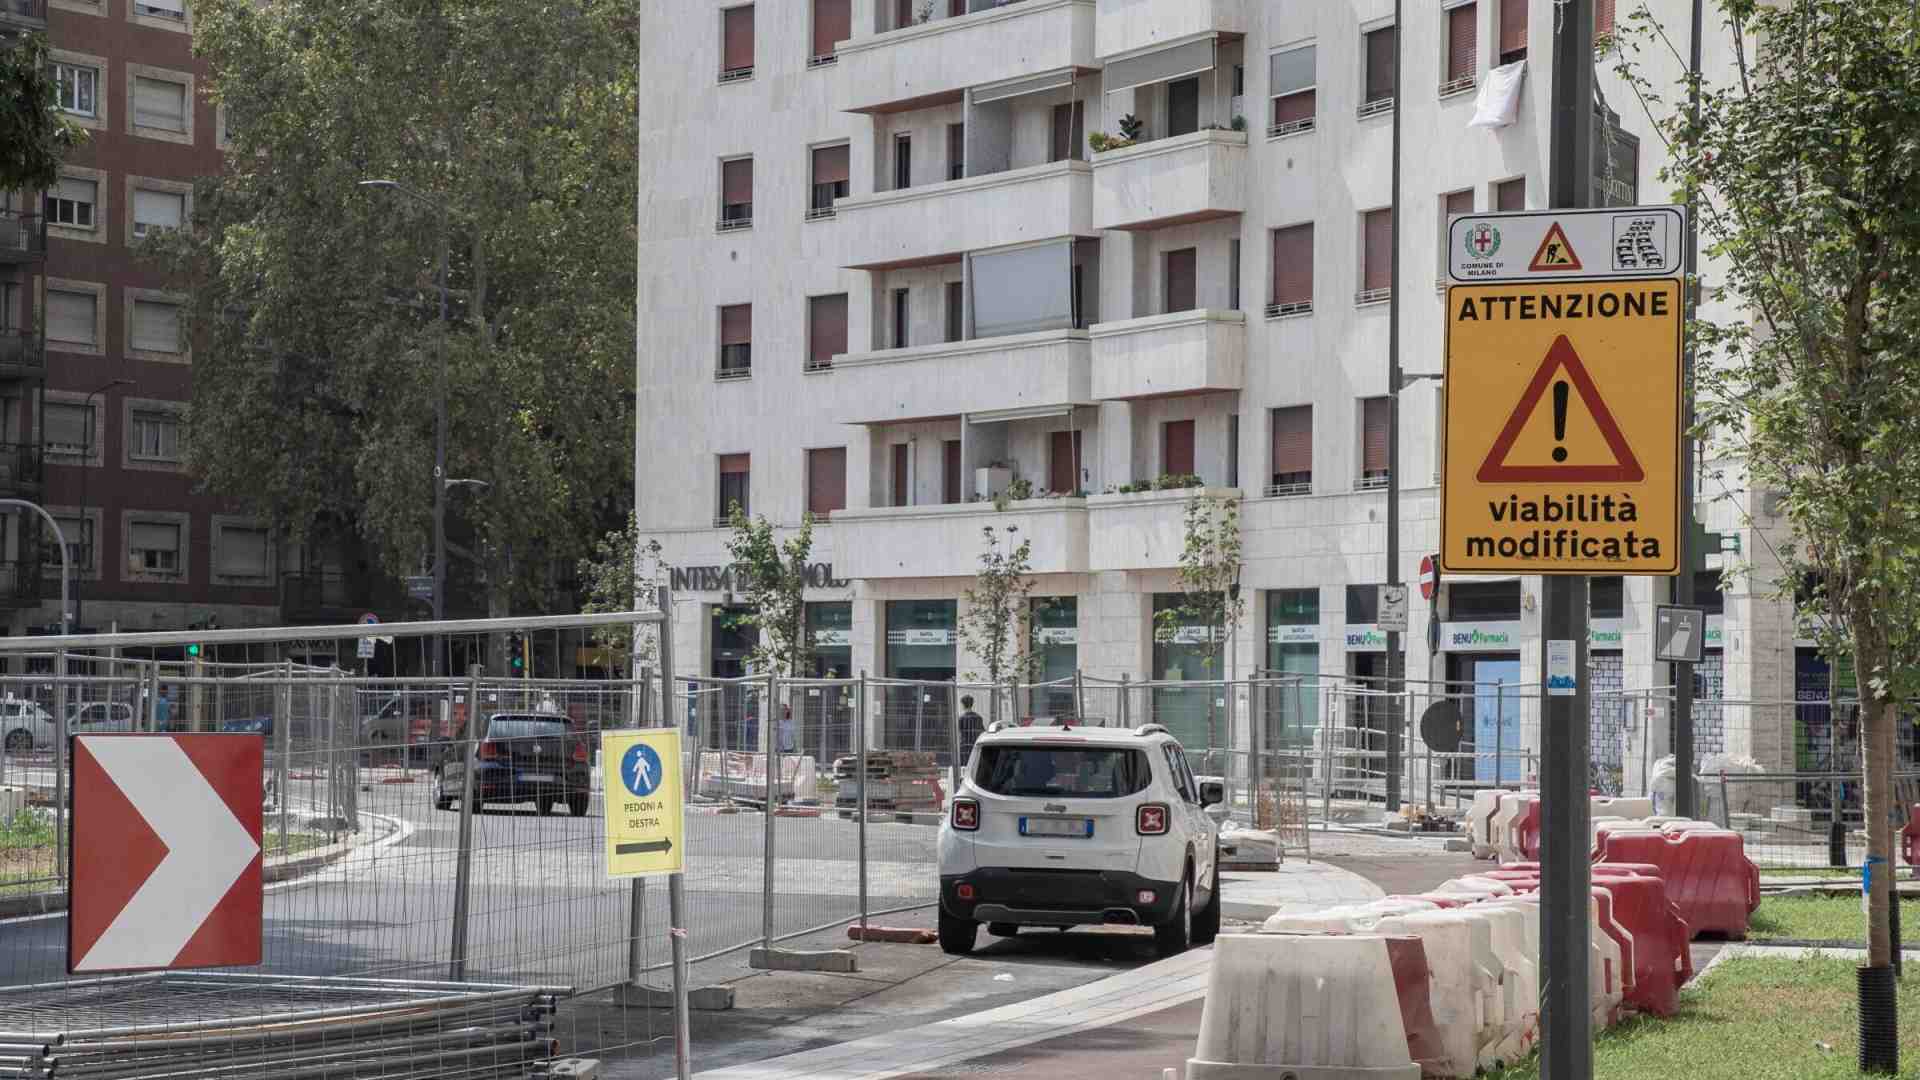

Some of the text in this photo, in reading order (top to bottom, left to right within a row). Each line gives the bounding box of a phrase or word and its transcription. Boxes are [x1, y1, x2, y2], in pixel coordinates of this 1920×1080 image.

[1460, 262, 1494, 270] COMUNE
[1458, 291, 1668, 321] ATTENZIONE
[1488, 493, 1638, 522] viabilità
[1466, 529, 1660, 558] modificata
[670, 565, 731, 591] INTESA
[1452, 632, 1471, 645] BENU
[624, 800, 663, 813] PEDONI A
[629, 817, 660, 829] DESTRA
